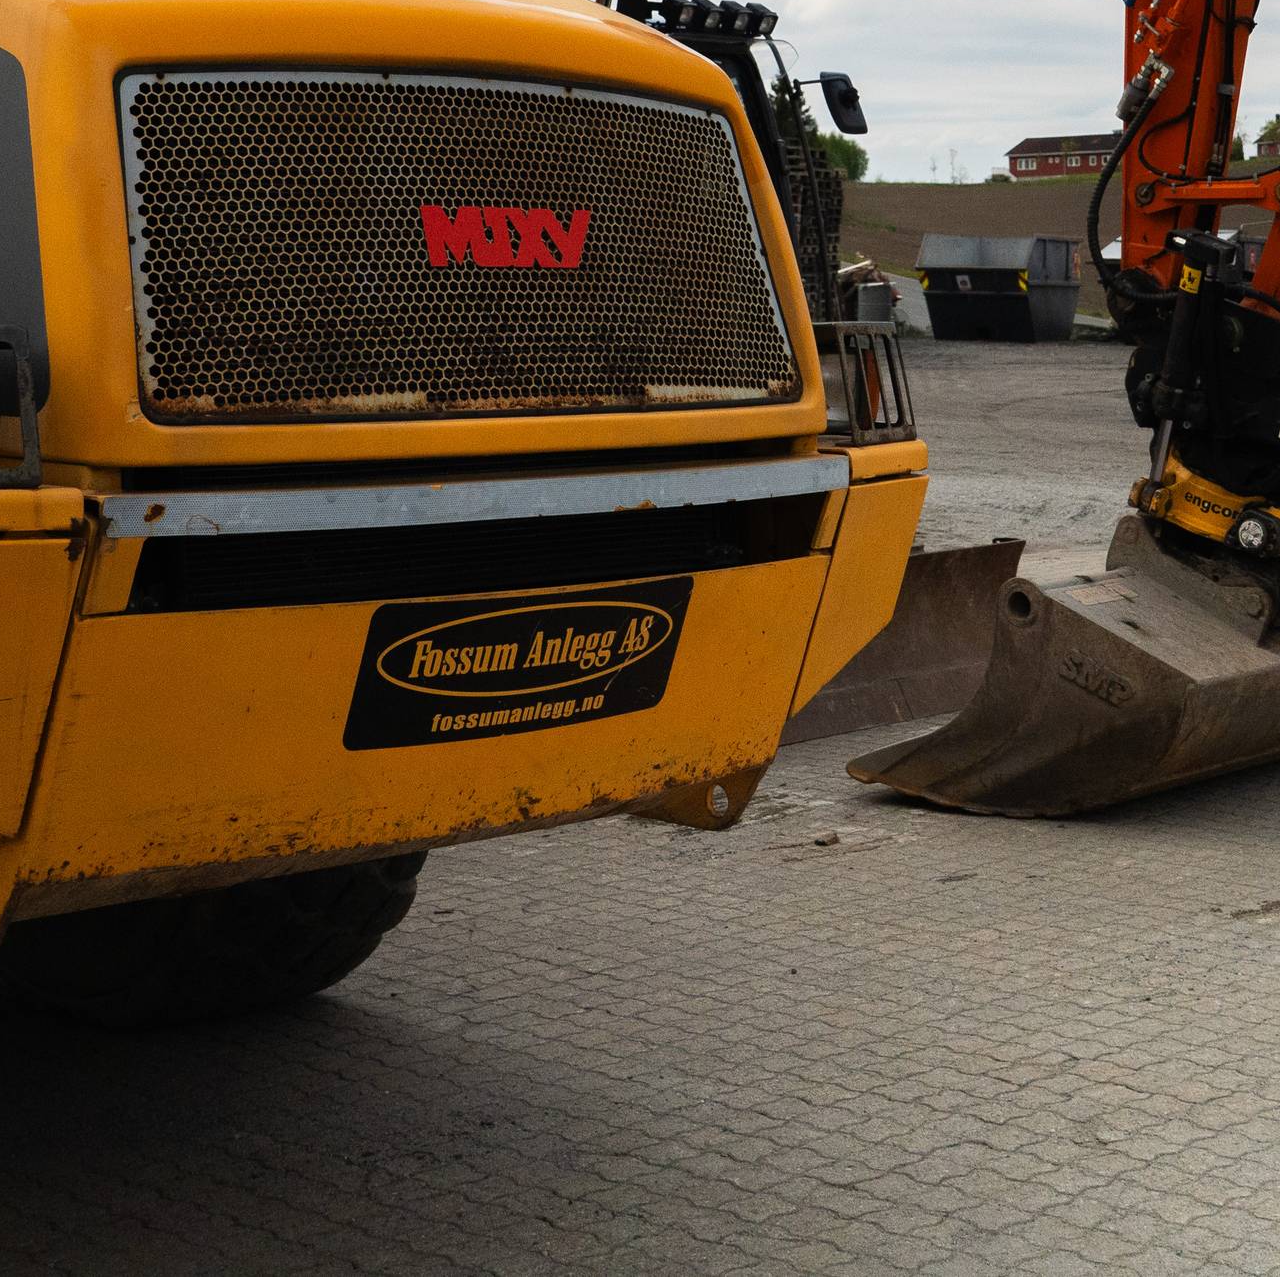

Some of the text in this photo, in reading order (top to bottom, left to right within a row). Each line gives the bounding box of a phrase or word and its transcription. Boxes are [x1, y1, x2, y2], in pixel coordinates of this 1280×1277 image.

[420, 205, 591, 269] MOXY
[408, 615, 655, 679] Fossum Anlegg AS
[431, 693, 605, 733] fossumanlegg.no
